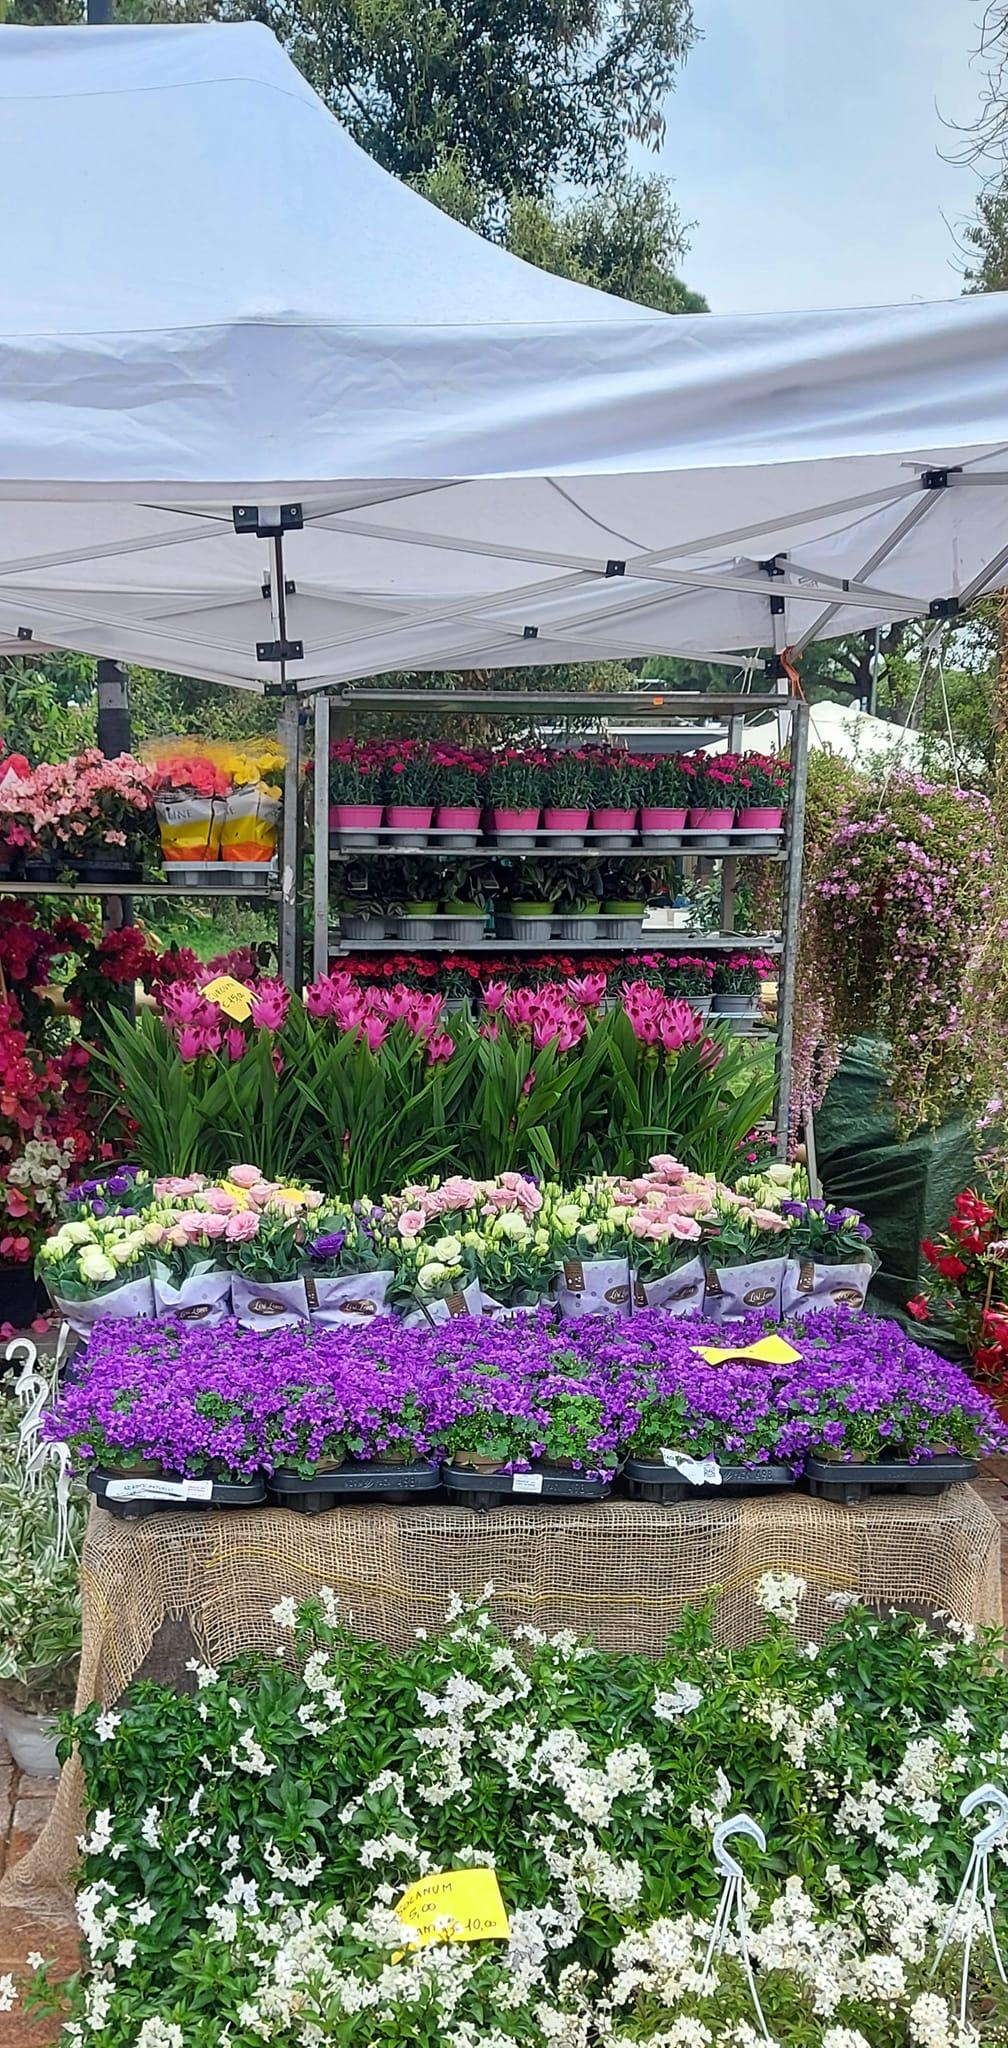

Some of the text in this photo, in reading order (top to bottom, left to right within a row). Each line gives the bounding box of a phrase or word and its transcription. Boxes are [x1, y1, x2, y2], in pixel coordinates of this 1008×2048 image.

[395, 1882, 453, 1915] SOLANUM
[408, 1902, 437, 1921] 5,00
[465, 1917, 497, 1932] 10,00
